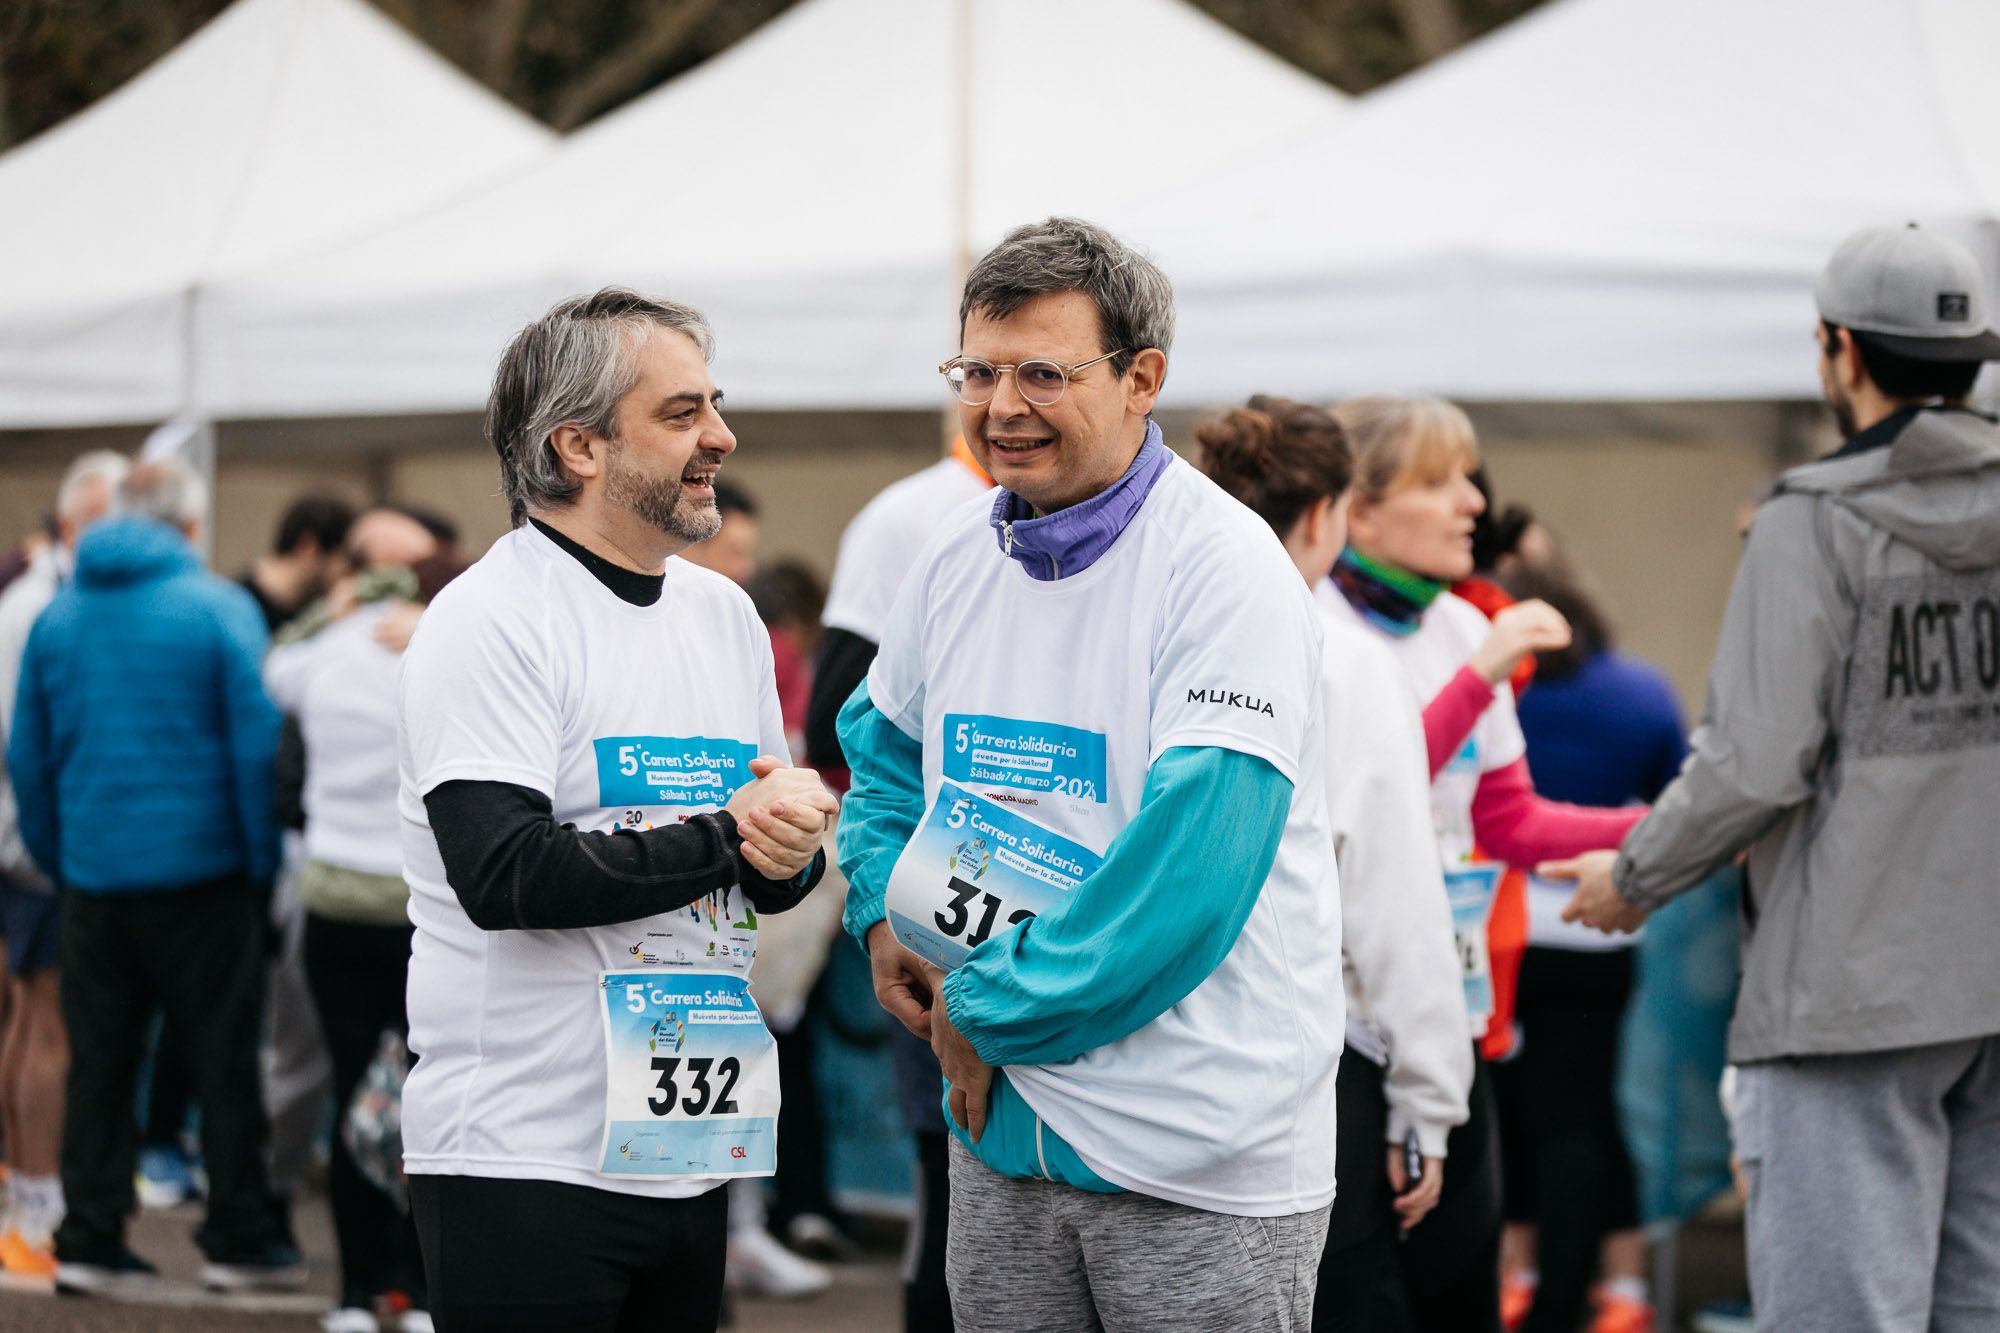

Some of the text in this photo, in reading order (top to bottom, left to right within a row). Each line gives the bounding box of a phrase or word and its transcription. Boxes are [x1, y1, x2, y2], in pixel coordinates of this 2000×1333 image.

[1885, 602, 1962, 699] ACT
[1187, 688, 1274, 718] MUKUA
[974, 752, 998, 762] évete
[1018, 735, 1077, 758] Solidaria
[1004, 771, 1010, 782] 7
[1011, 771, 1022, 784] de
[1024, 775, 1050, 788] marzo
[695, 789, 709, 799] de
[1017, 797, 1039, 806] MADRID
[970, 813, 1017, 847] Carrera
[1019, 837, 1084, 877] Solidaria
[999, 850, 1072, 888] Muévete por la Salud
[934, 875, 1038, 949] 31
[650, 989, 702, 1006] Carrera
[647, 1056, 741, 1117] 332
[730, 1146, 747, 1158] CSL
